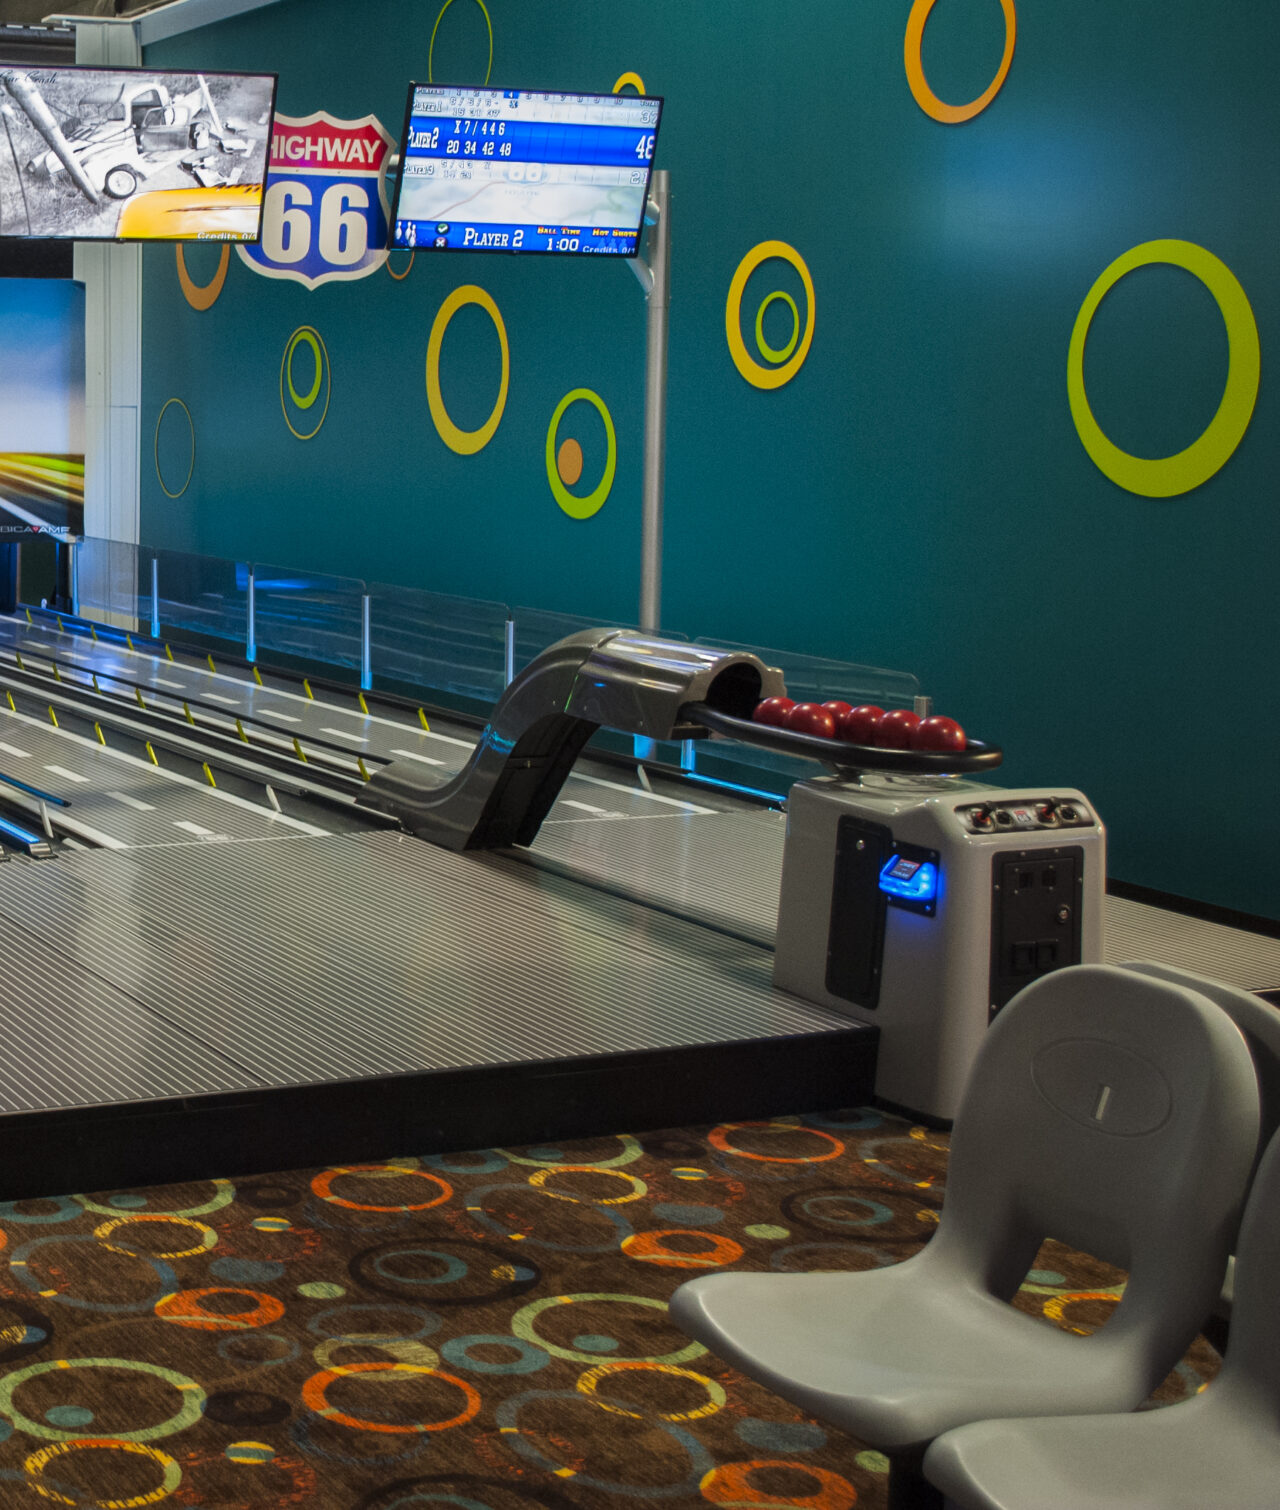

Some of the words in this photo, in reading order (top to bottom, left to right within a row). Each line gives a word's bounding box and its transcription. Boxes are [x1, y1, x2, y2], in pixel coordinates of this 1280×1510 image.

[454, 120, 461, 134] X
[464, 120, 471, 134] 7
[481, 121, 488, 135] 4
[489, 122, 496, 136] 4
[498, 122, 505, 136] 6
[271, 135, 381, 164] HIGHWAY
[446, 140, 460, 154] 20
[464, 141, 477, 155] 34
[482, 142, 494, 155] 42
[499, 142, 512, 156] 48
[262, 181, 369, 265] 66
[512, 229, 524, 248] 2
[592, 228, 609, 236] HOT
[546, 238, 580, 251] 1:00
